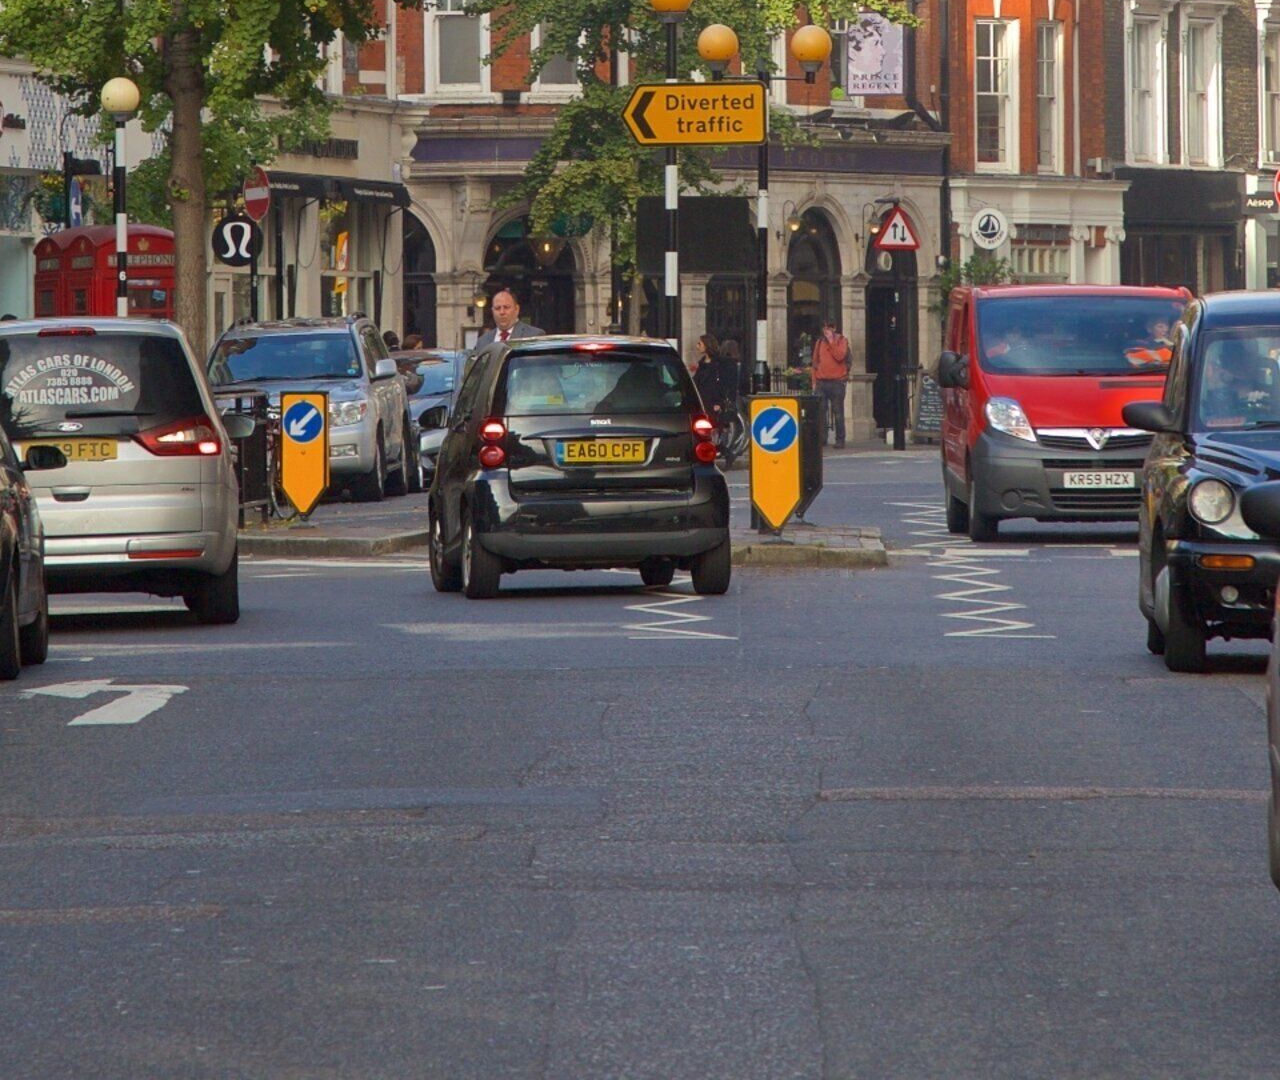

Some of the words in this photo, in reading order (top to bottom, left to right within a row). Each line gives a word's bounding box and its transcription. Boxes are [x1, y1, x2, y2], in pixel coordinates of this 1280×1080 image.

[852, 72, 899, 81] PRINCE
[852, 82, 899, 90] REGENT
[665, 93, 755, 111] Diverted
[677, 116, 743, 133] traffic
[4, 364, 38, 398] ATLAS
[36, 354, 71, 371] CARS
[73, 354, 91, 367] OF
[90, 357, 136, 394] LONDON
[19, 386, 120, 405] ATLASCARS.COM
[78, 442, 111, 457] FTC
[567, 442, 608, 458] EA60
[611, 442, 641, 458] CPF
[1069, 474, 1102, 485] KR59
[1105, 473, 1129, 485] HZX
